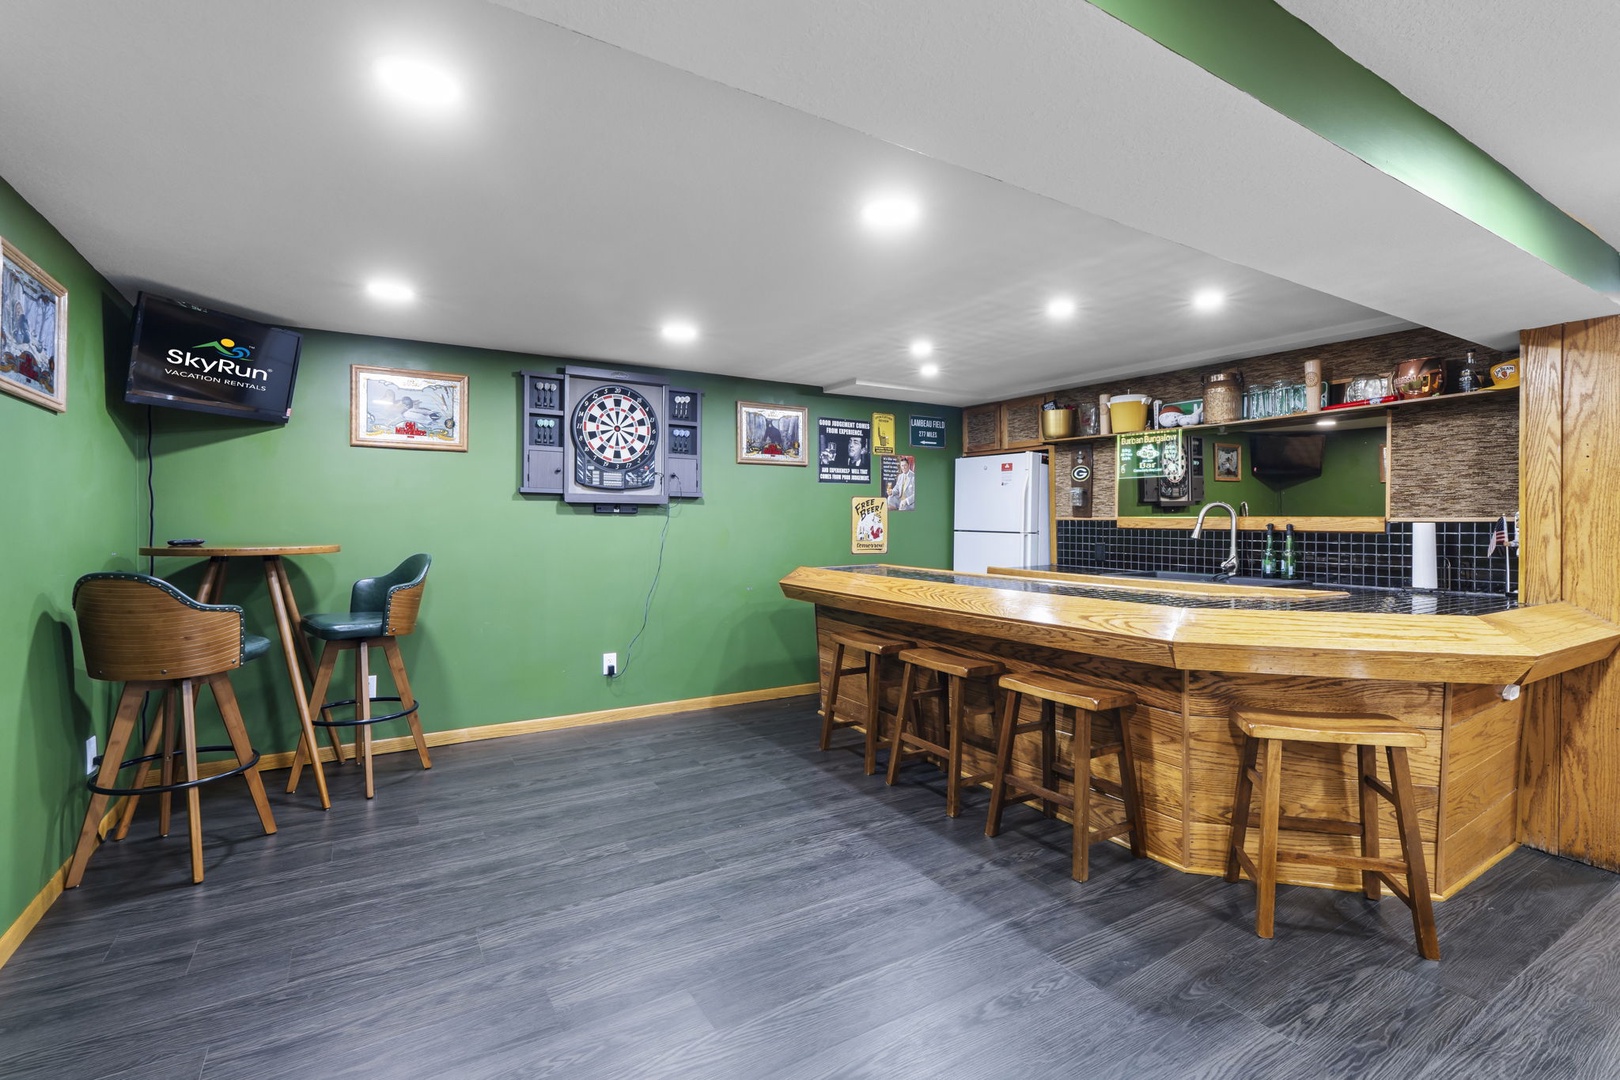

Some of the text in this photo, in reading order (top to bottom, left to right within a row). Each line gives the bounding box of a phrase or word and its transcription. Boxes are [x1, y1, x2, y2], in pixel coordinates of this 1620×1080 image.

[166, 349, 268, 381] SkyRun
[164, 368, 267, 392] VACATION RENTALS
[832, 420, 855, 428] JUDGEMENT
[910, 418, 946, 429] LAMBEAU FIELD
[838, 428, 864, 436] EXPERIENCE.
[1144, 434, 1177, 444] Bungalow
[1074, 468, 1088, 479] G
[855, 499, 876, 516] FREE
